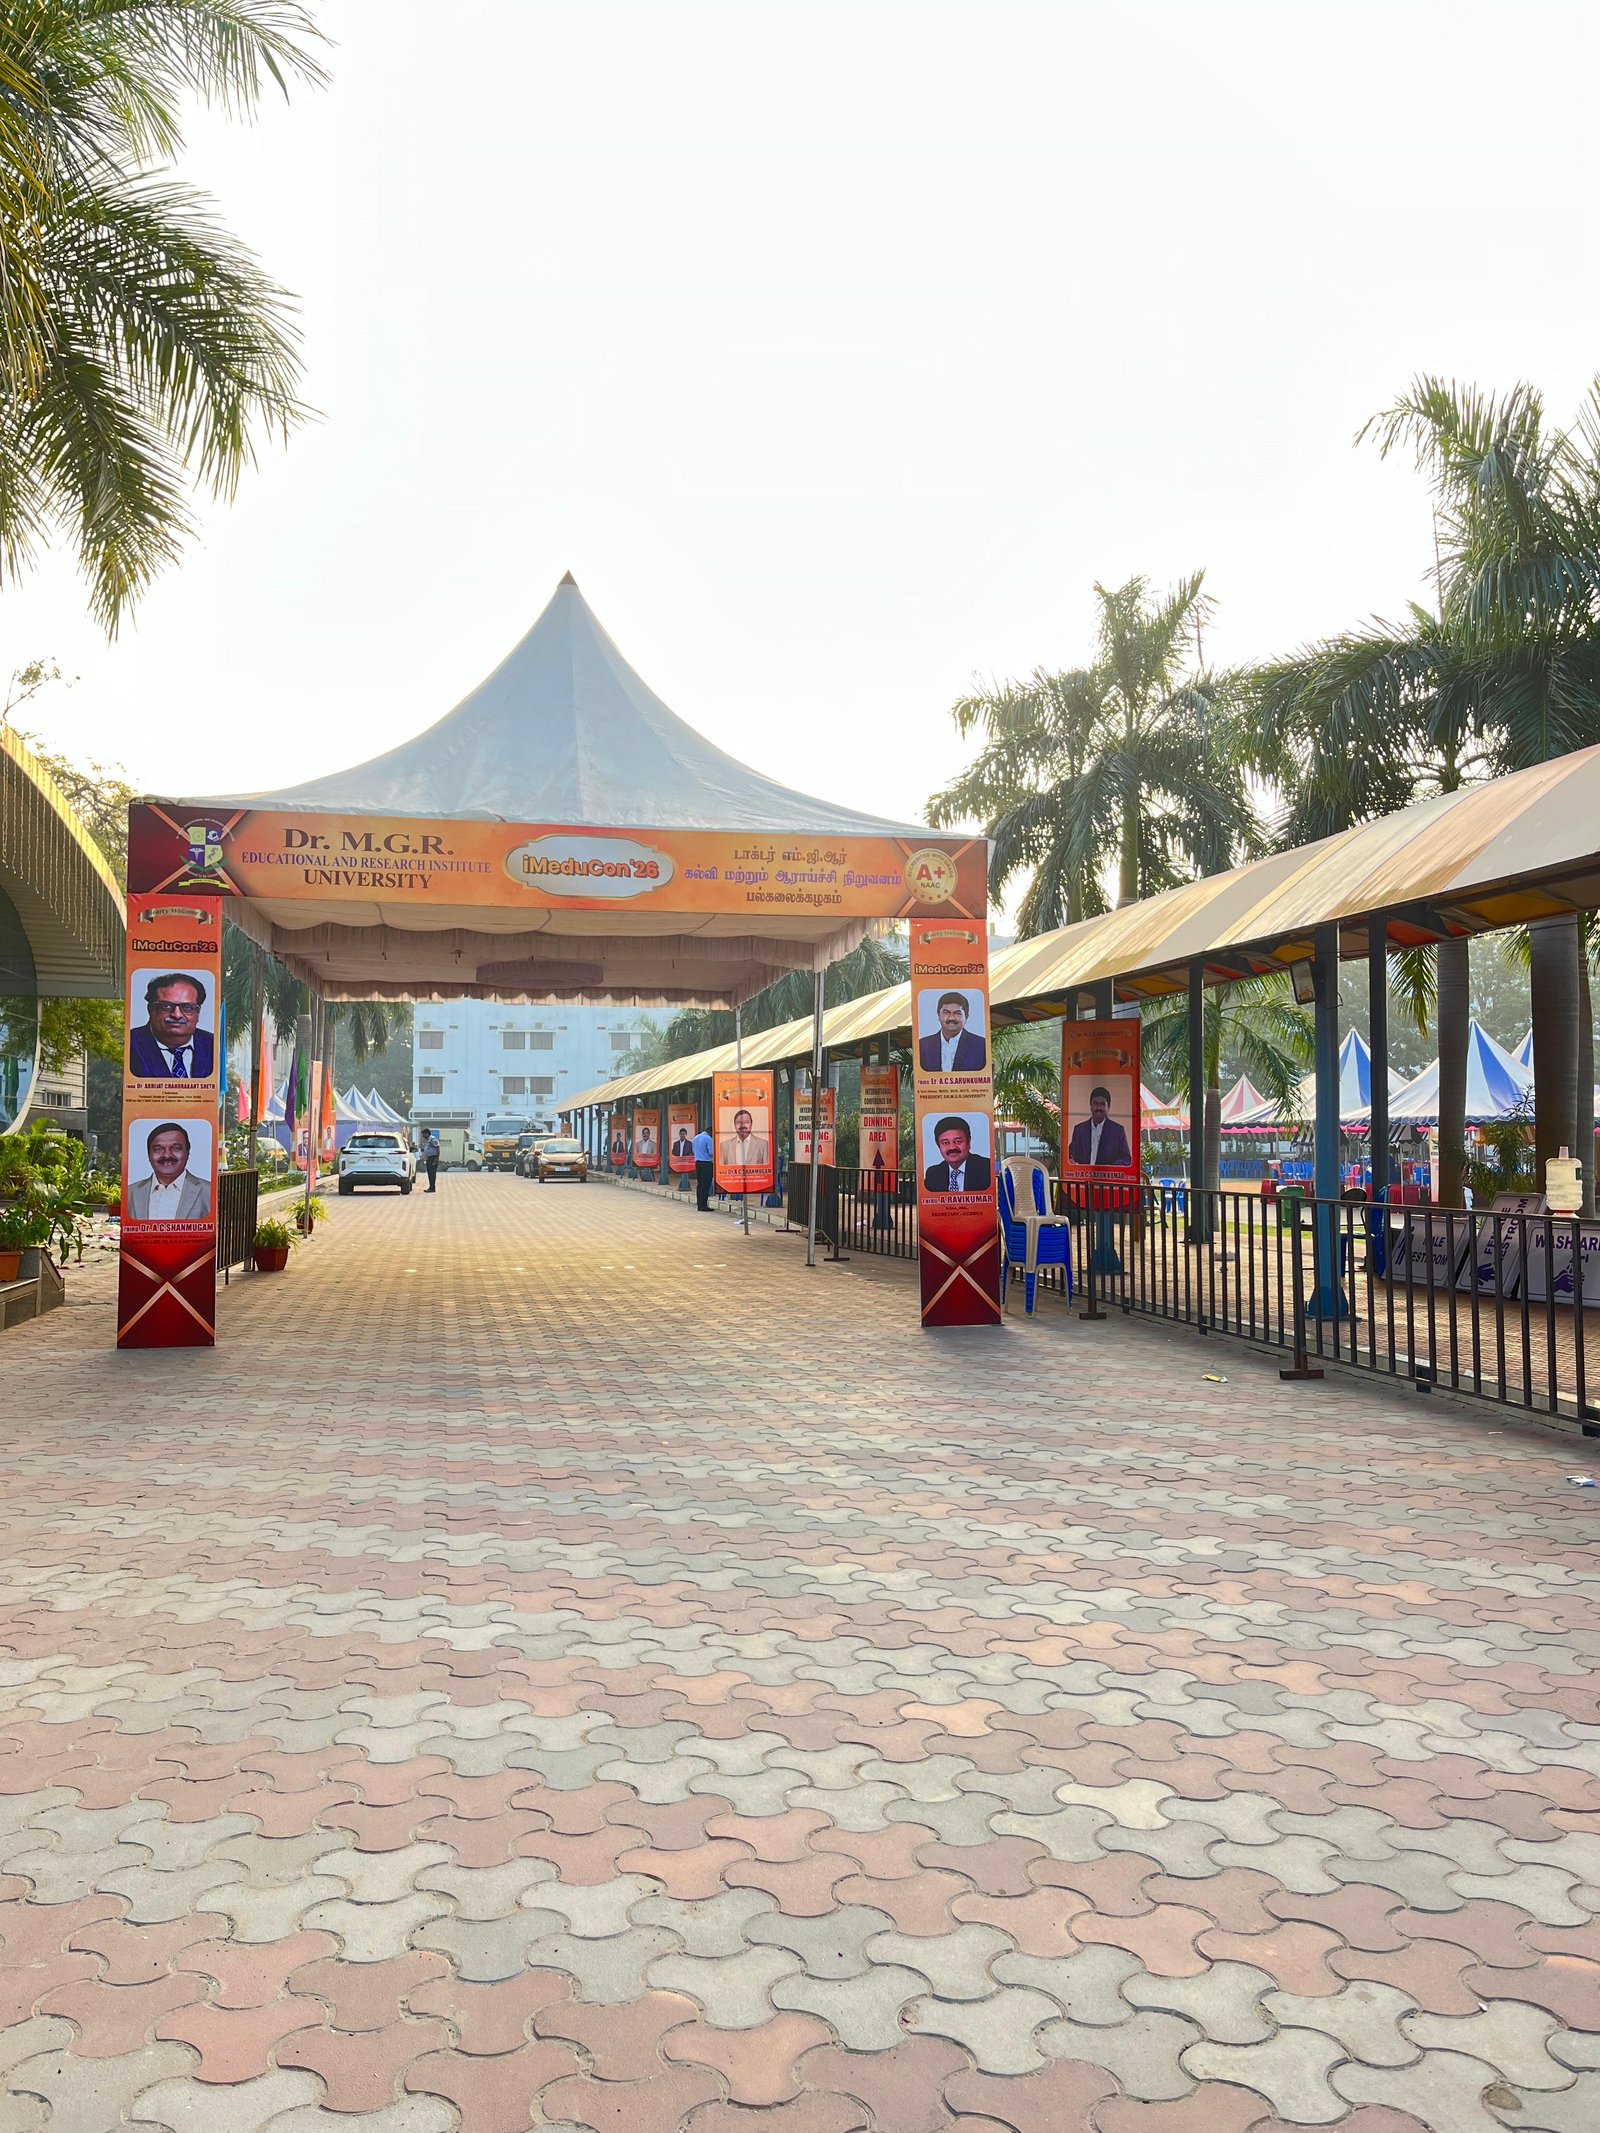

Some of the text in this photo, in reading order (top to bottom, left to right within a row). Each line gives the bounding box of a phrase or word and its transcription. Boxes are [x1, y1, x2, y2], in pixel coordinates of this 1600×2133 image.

[282, 828, 455, 856] Dr. M.G.R.
[241, 851, 492, 874] EDUCATIONAL AND RESEARCH INSTITUTE
[734, 845, 848, 866] டாக்டர் எம்.ஜி.ஆர்
[522, 854, 660, 879] iMeduCon'26
[684, 863, 902, 889] கல்வி மற்றும் ஆராய்ச்சி நிறுவனம்
[916, 864, 946, 881] A+
[303, 868, 433, 889] UNIVERSITY
[746, 886, 843, 908] பல்கலைக்கழகம்
[132, 939, 218, 953] iMeduCon'26
[863, 1116, 893, 1127] DINNING
[869, 1131, 887, 1142] AREA
